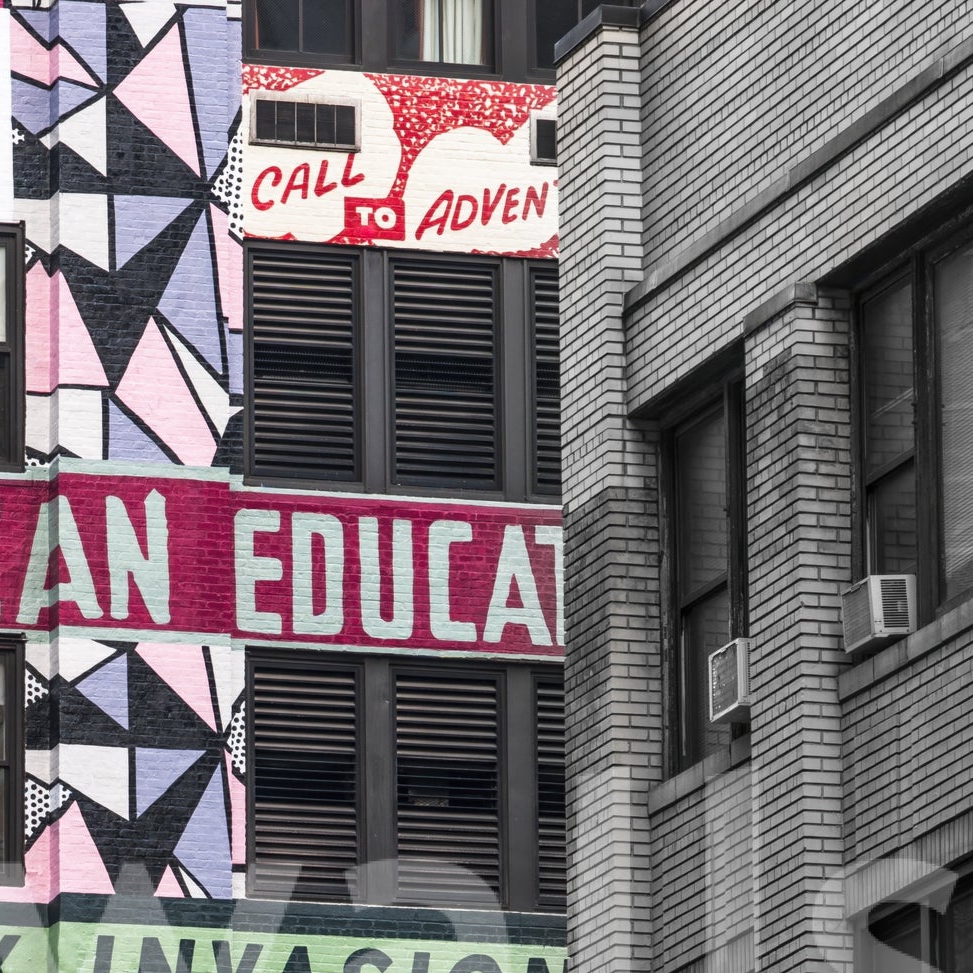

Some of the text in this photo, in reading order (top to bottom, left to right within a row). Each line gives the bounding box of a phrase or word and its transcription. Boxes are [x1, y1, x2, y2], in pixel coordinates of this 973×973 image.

[251, 152, 365, 211] CALL
[415, 180, 559, 240] ADVEN
[356, 206, 398, 229] TO
